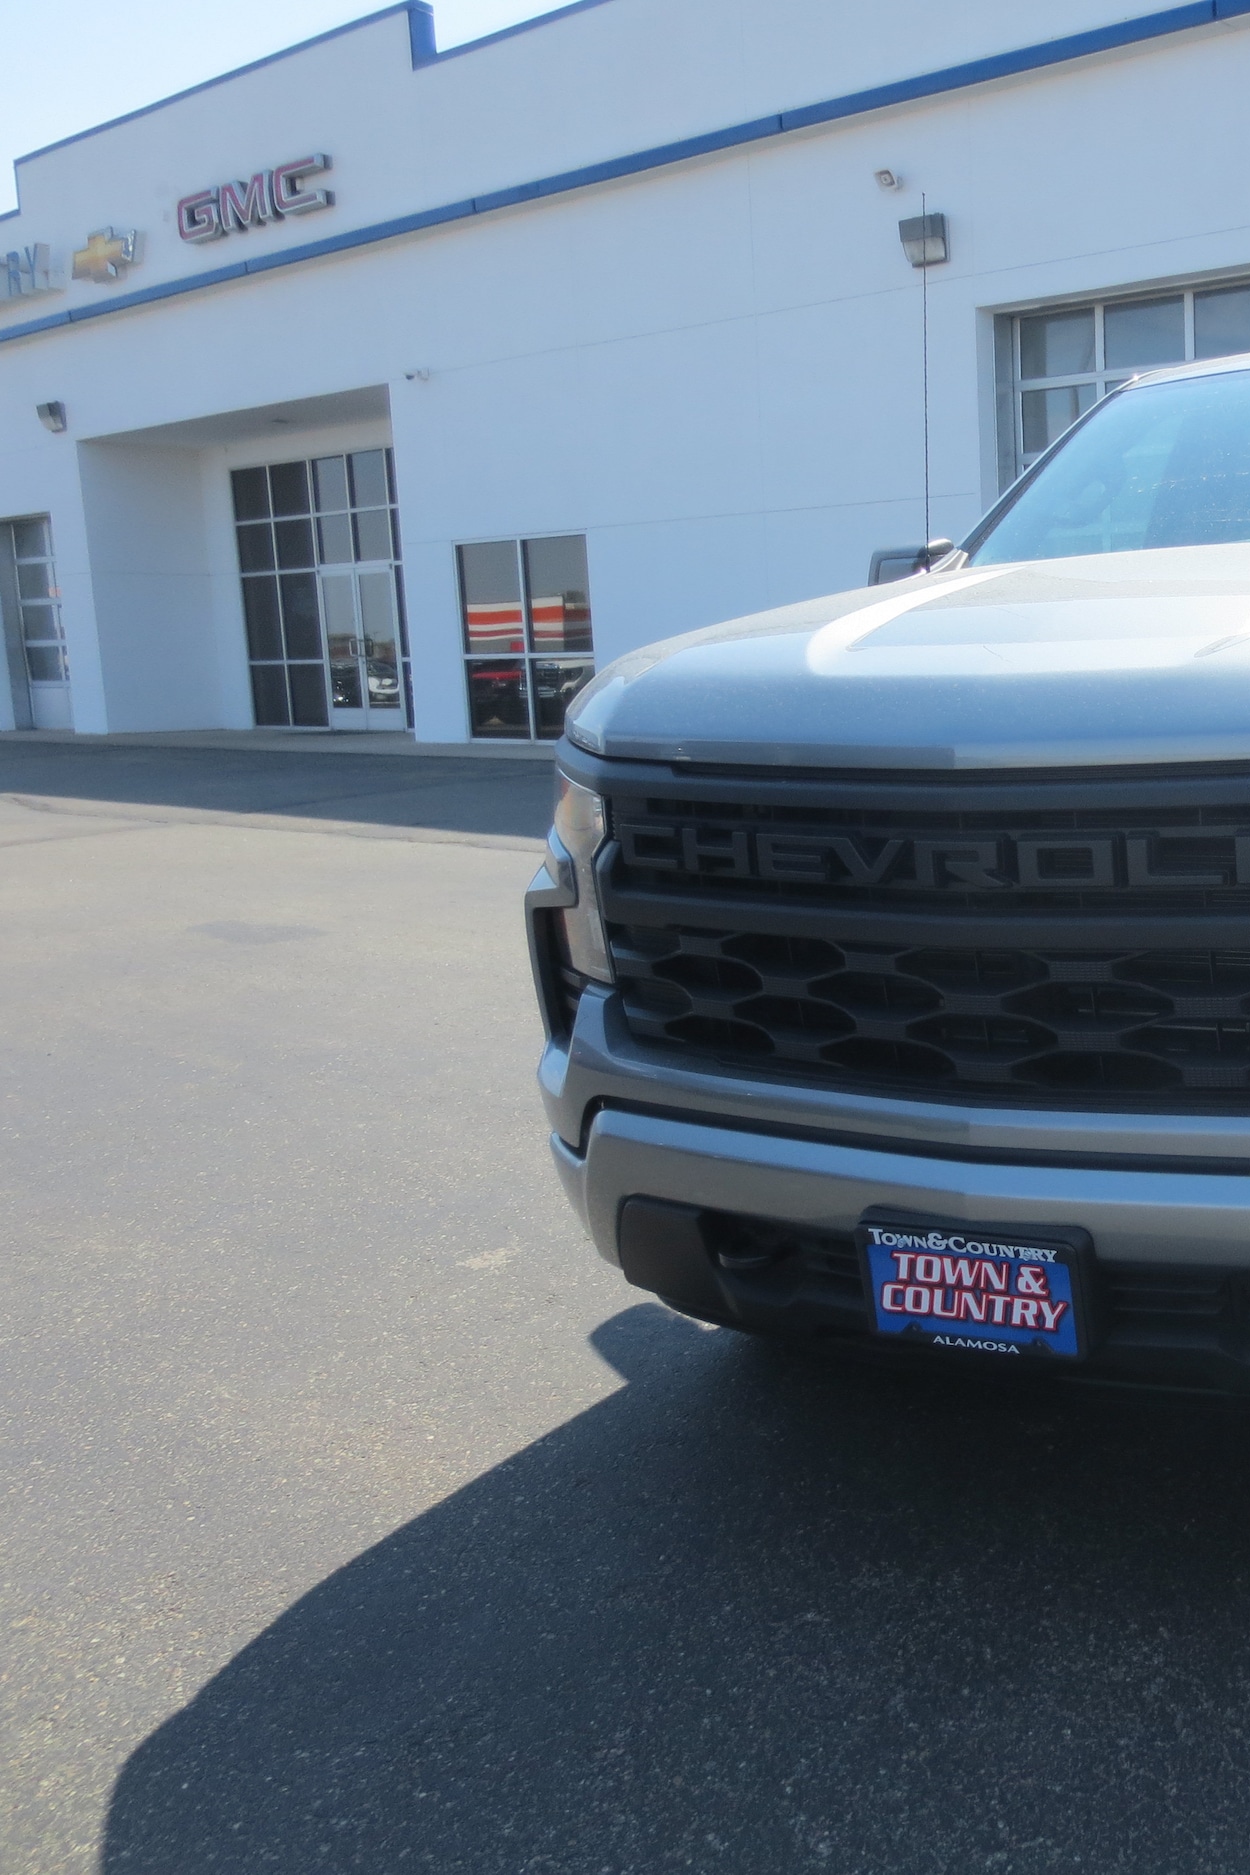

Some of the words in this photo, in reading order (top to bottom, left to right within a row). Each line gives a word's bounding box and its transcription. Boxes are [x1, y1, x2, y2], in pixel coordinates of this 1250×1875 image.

[177, 153, 335, 244] GMC
[892, 1251, 1009, 1292] TOWN
[1017, 1265, 1049, 1297] &
[881, 1281, 1067, 1332] COUNTRY
[933, 1335, 1020, 1354] ALAMOSA
